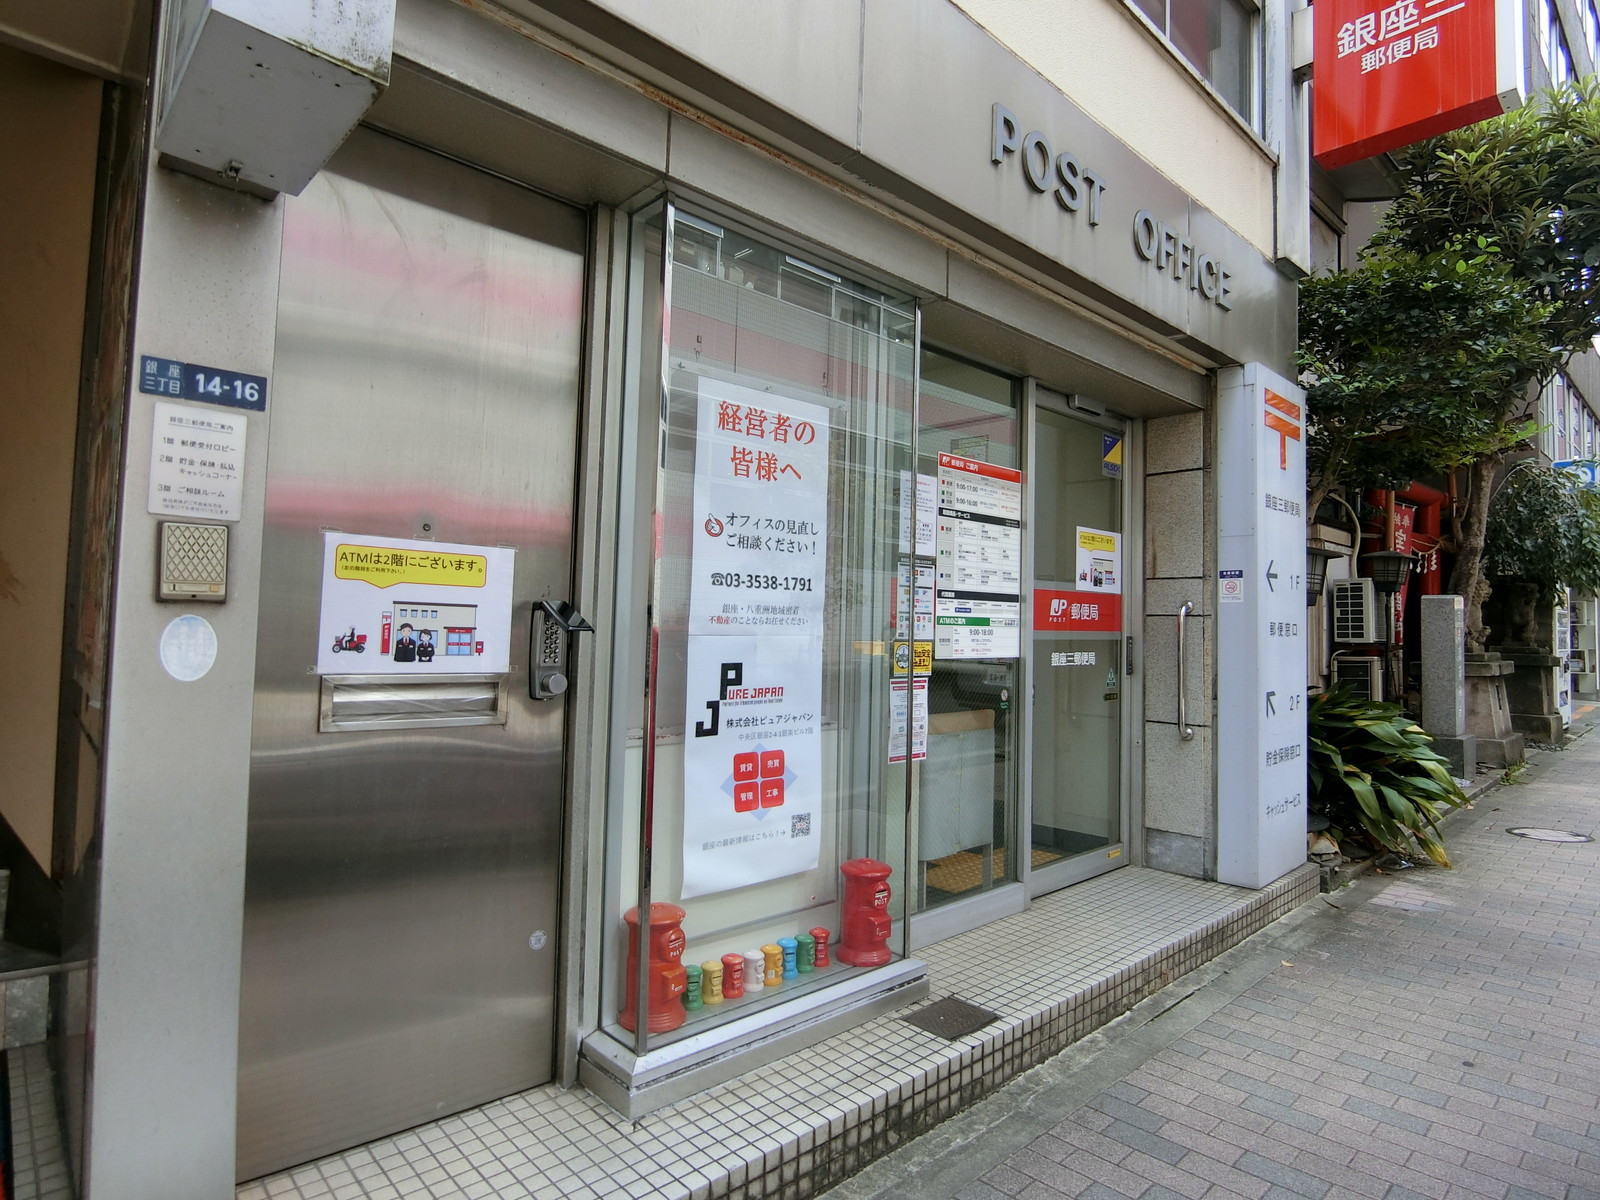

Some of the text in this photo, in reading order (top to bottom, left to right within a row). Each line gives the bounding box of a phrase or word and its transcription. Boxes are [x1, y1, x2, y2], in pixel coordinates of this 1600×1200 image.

[1361, 26, 1438, 75] 郵便局
[991, 102, 1232, 312] POST OFFICE
[146, 360, 180, 378] 銀座
[144, 376, 180, 394] 三丁目
[195, 373, 259, 401] 14-16
[718, 400, 816, 445] 経営者の
[163, 437, 236, 452] 1階 郵便受付ロビー
[159, 455, 173, 463] 2階
[730, 445, 802, 482] 皆様へ
[158, 484, 224, 497] 3階 ご相談ルーム
[1265, 493, 1300, 517] 銀座三郵便局
[725, 512, 819, 535] オフィスの見直し
[726, 533, 816, 555] ご相談ください！
[340, 552, 483, 573] ATMは2階にございます。
[724, 573, 812, 591] 03-3538-1791
[722, 603, 800, 615] 銀座・八重洲地域密着
[1071, 603, 1099, 620] 郵便局
[709, 615, 809, 626] 不動産のことならお任せください
[1269, 621, 1298, 637] 郵便窓口
[1051, 652, 1096, 666] 銀座三郵便局
[751, 687, 784, 699] JAPAN
[726, 713, 814, 729] 株式会社ピュアジャパン
[767, 759, 780, 769] 売買
[1266, 744, 1301, 767] 貯金保険窓口
[740, 791, 753, 801] 管理
[766, 788, 778, 797] 工事
